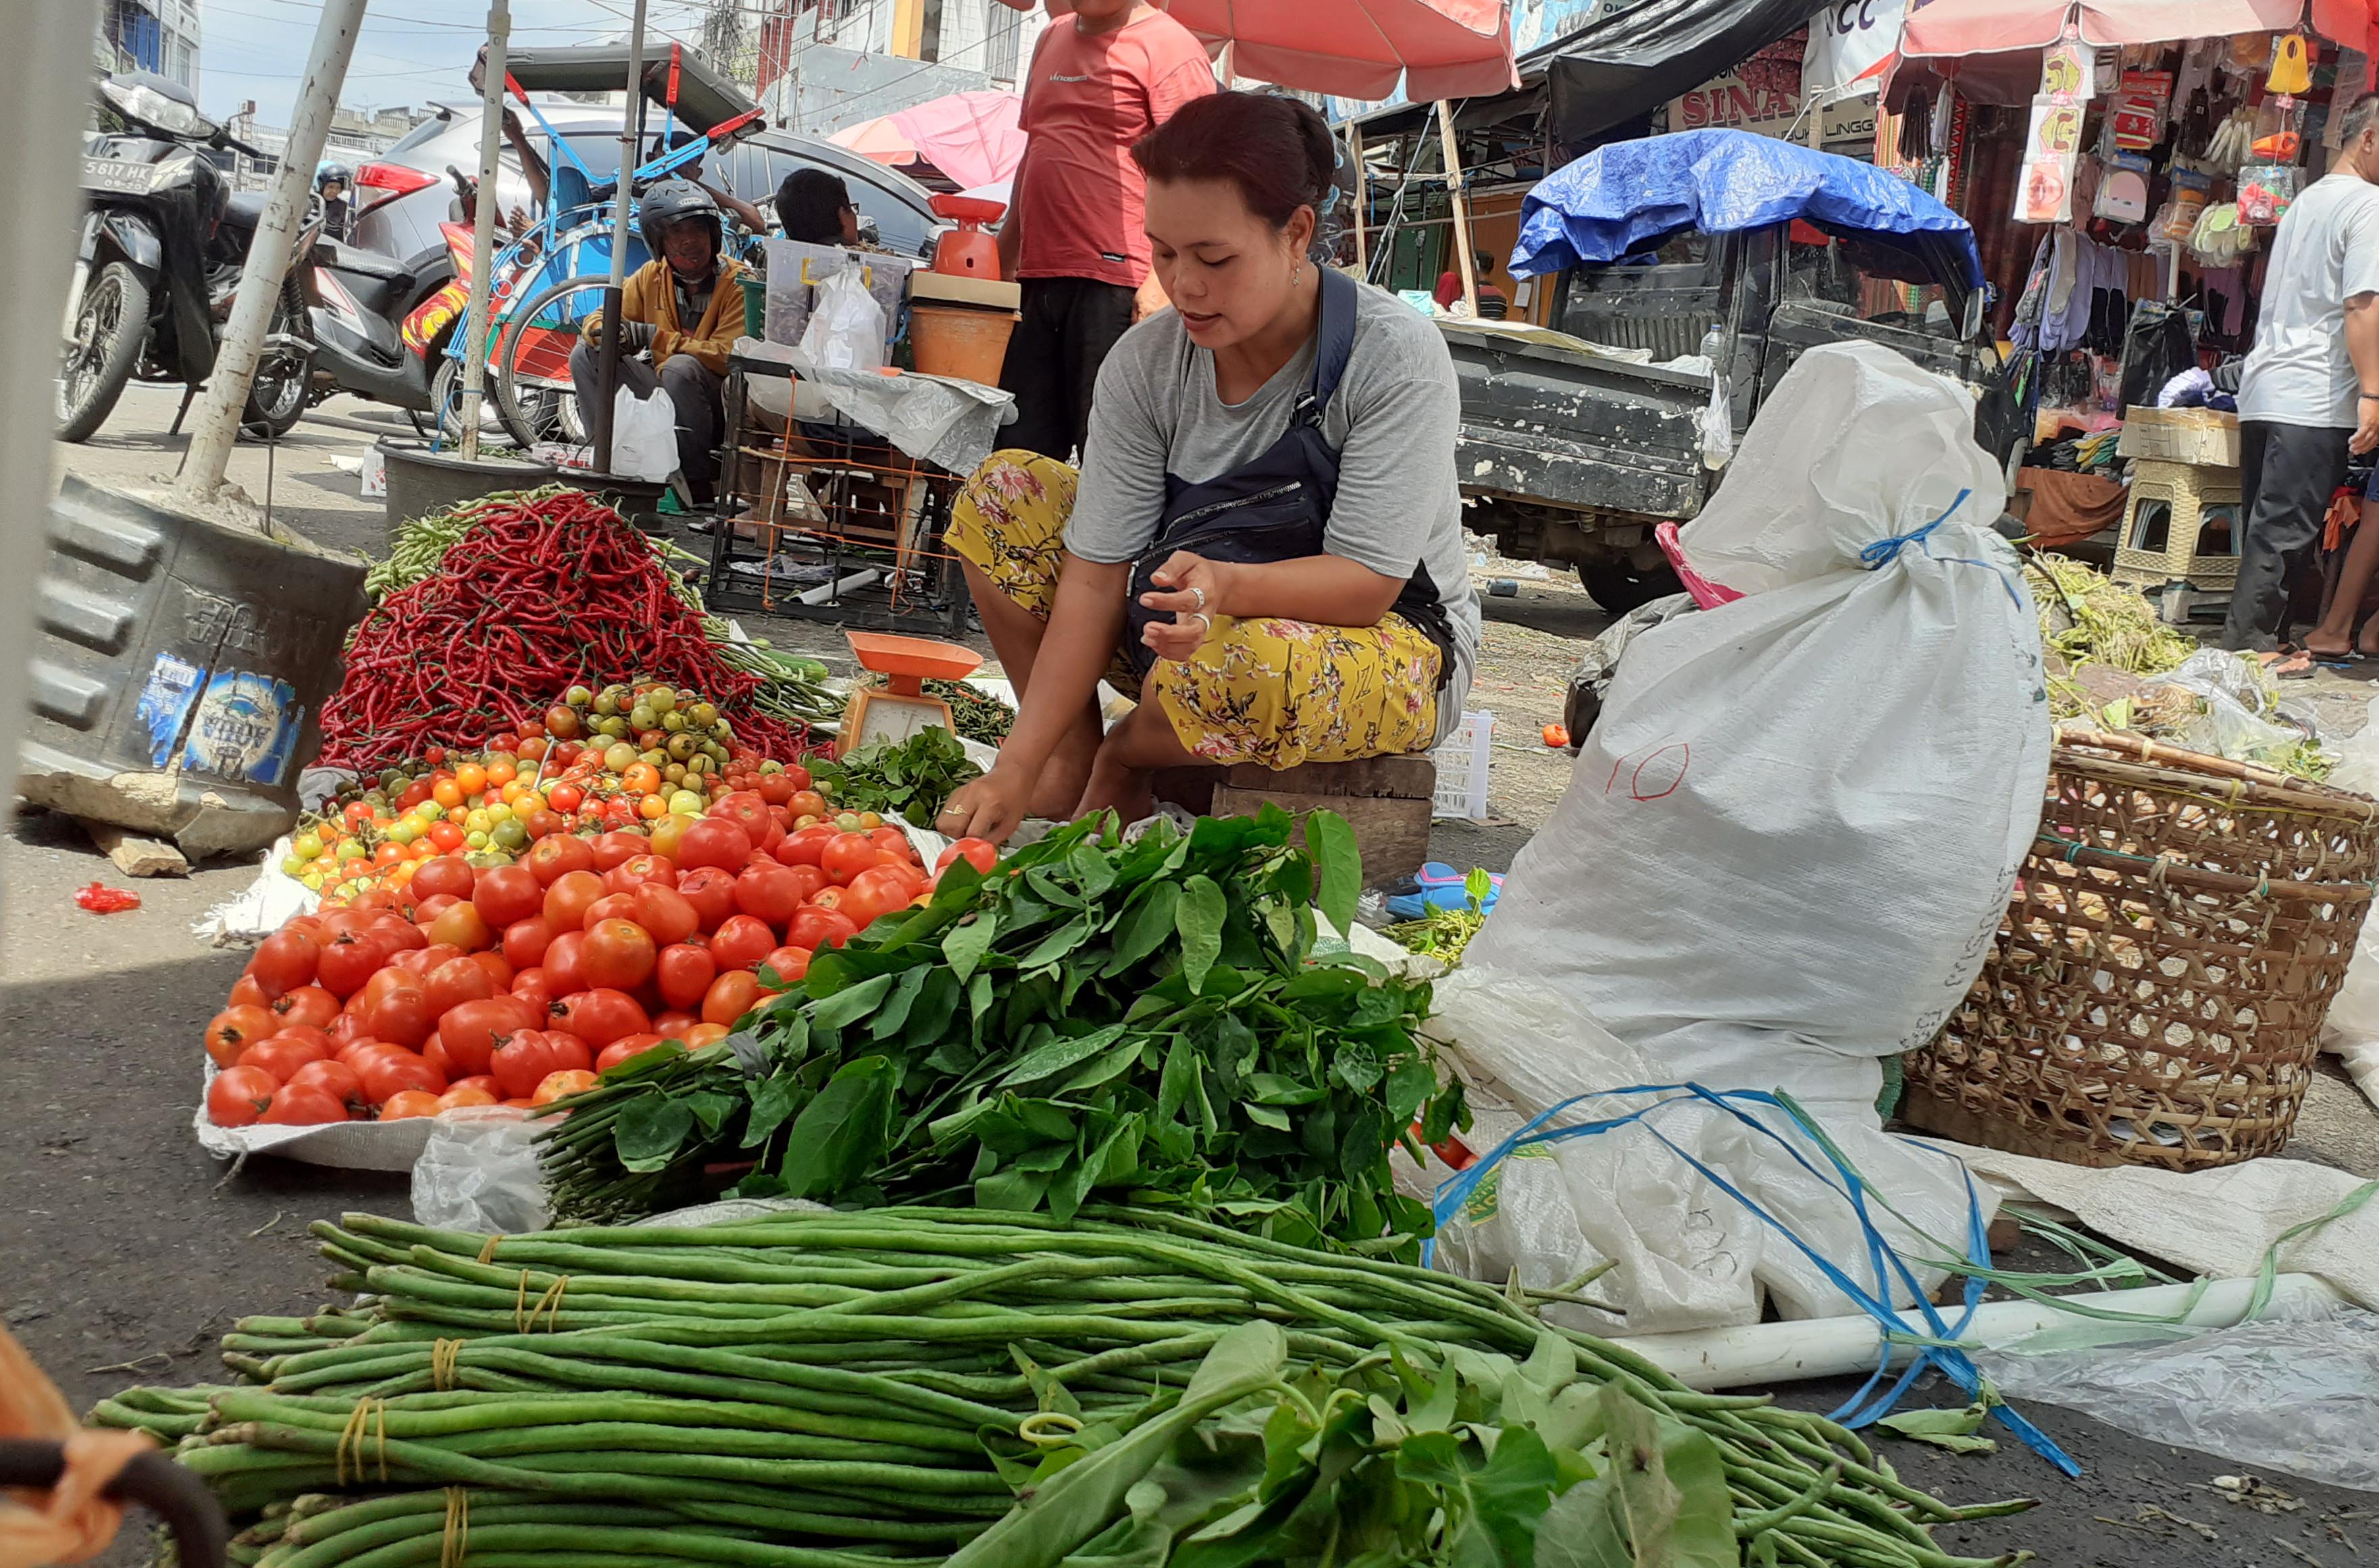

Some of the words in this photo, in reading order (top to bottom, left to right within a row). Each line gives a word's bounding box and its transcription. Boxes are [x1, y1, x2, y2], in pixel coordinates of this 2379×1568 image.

[1681, 84, 1801, 127] SINA
[1825, 119, 1875, 137] LINGG
[84, 161, 125, 177] 5617
[126, 165, 150, 180] HK
